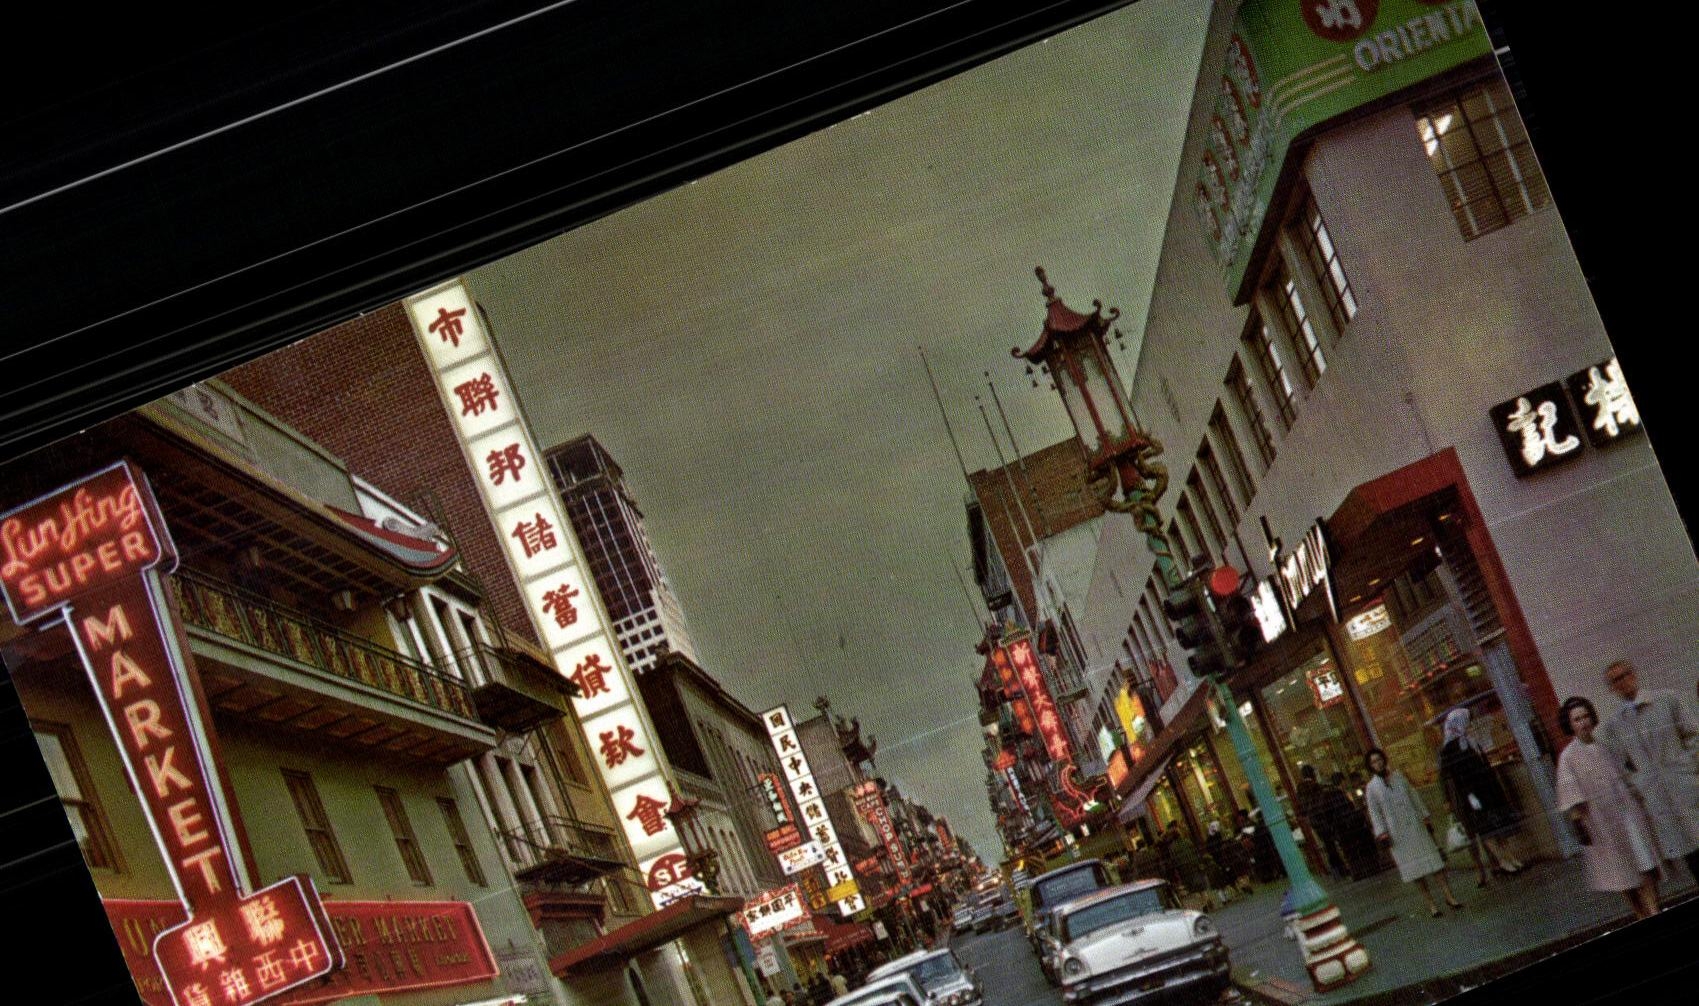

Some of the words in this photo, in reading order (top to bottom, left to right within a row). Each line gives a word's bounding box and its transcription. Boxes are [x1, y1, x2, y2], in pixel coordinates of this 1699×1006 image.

[1, 517, 59, 577] Lun
[60, 483, 142, 551] Hing
[19, 530, 150, 606] SUPER
[82, 603, 222, 894] MARKET
